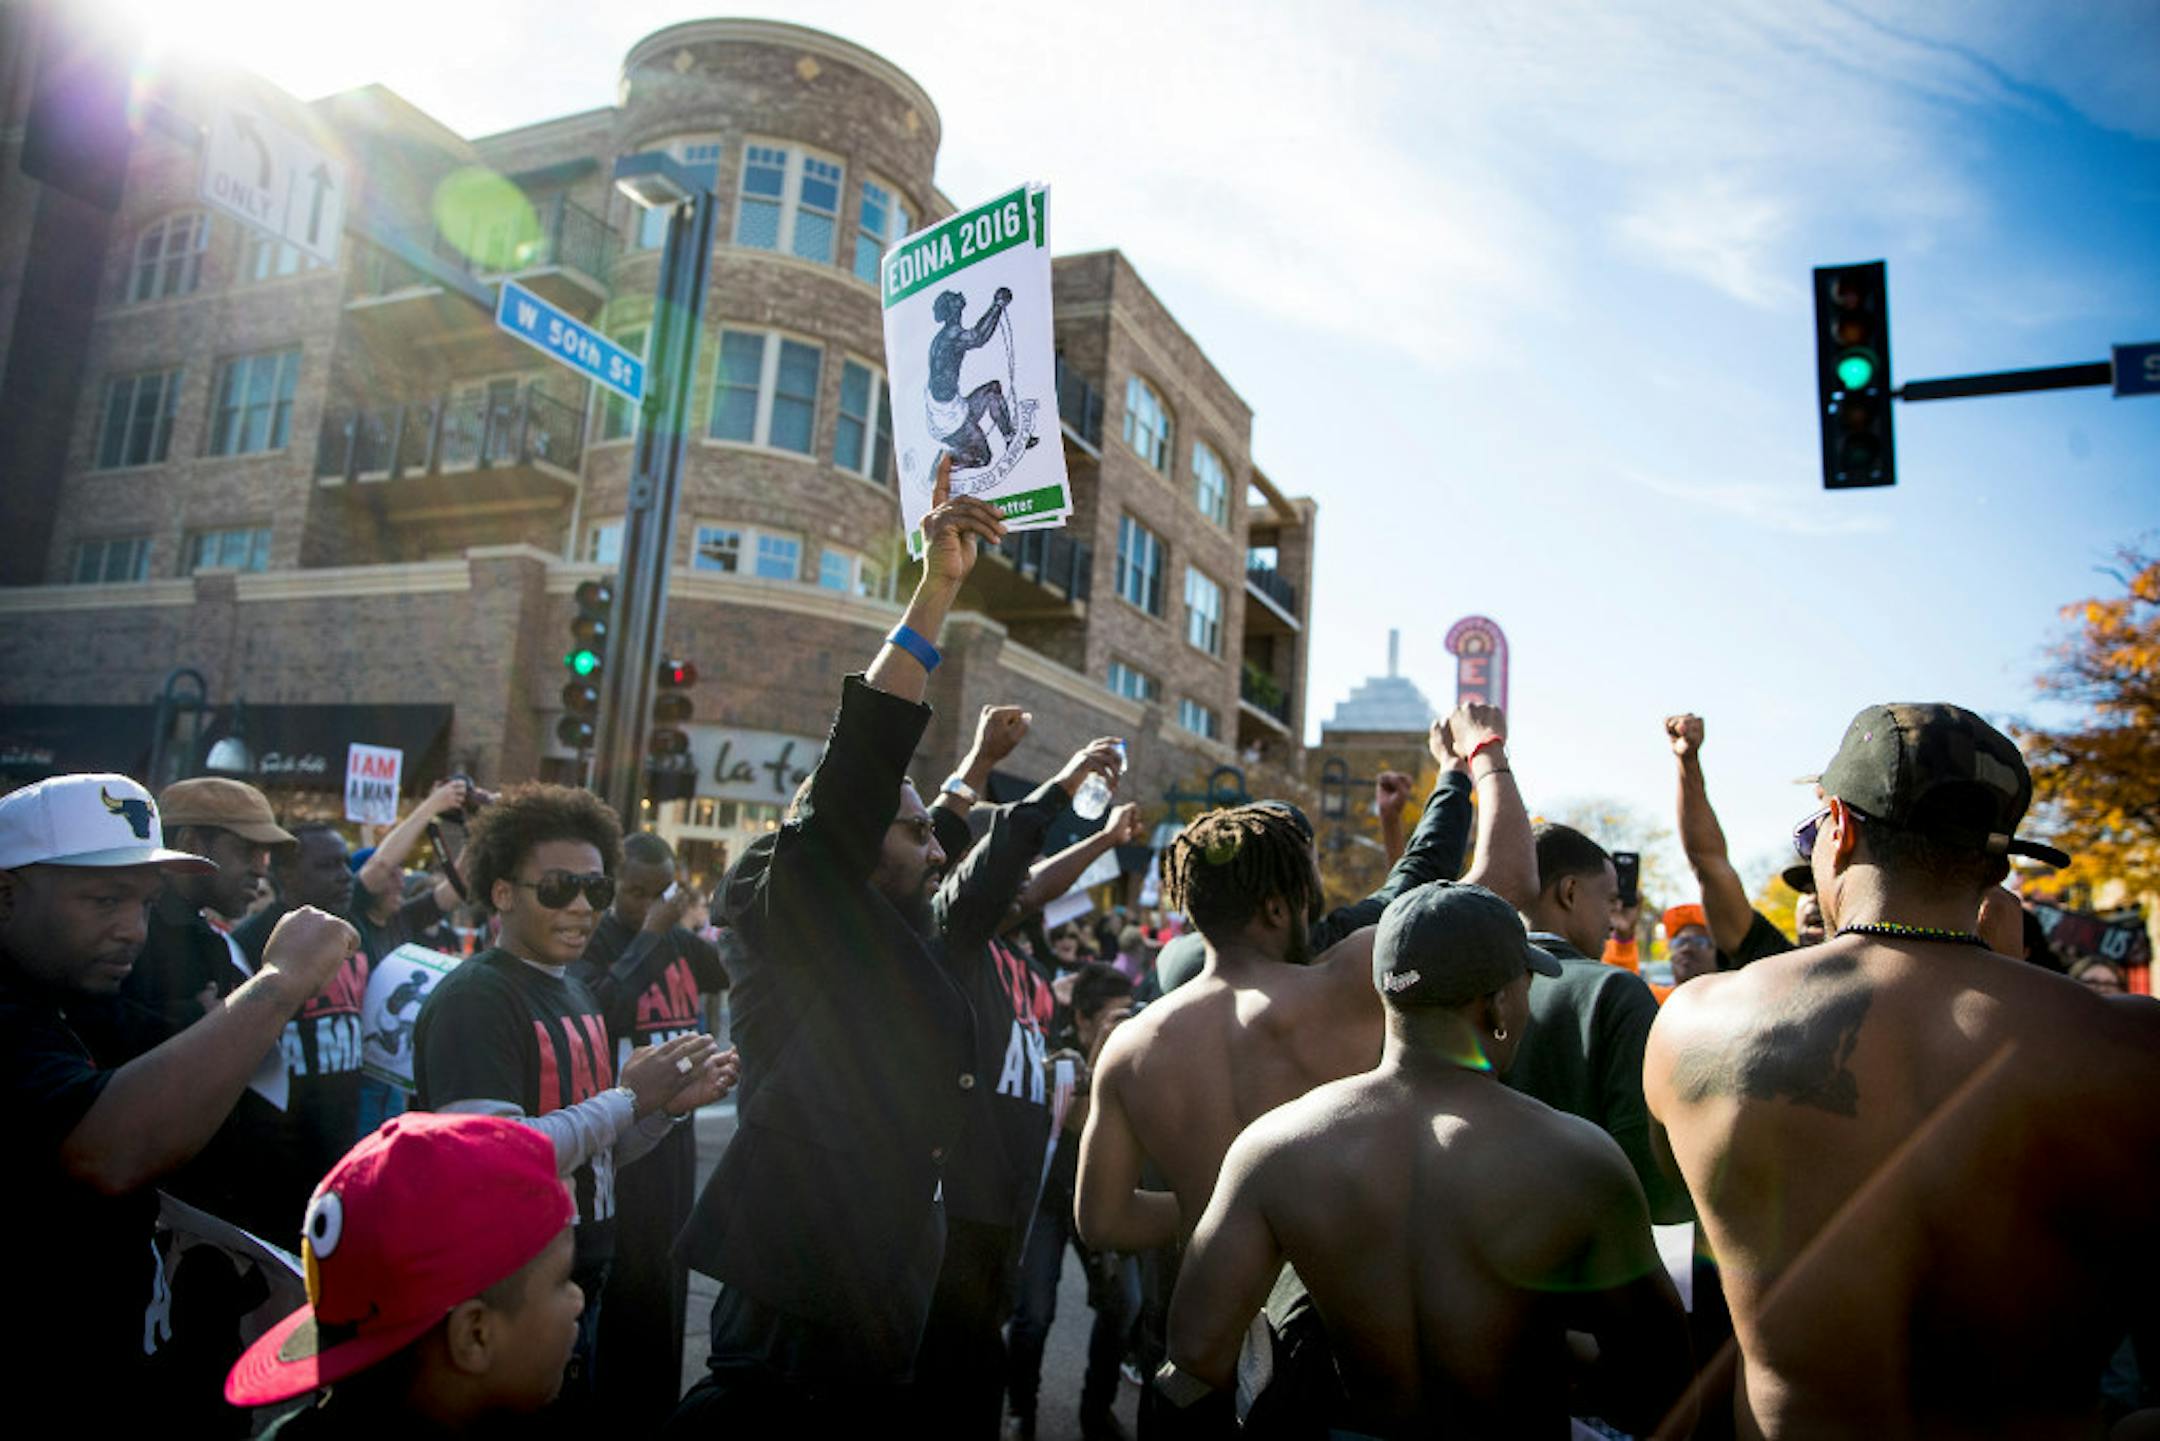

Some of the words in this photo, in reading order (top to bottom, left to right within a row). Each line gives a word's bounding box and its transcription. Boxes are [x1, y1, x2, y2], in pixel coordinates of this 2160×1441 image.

[213, 170, 273, 220] ONLY
[889, 233, 955, 295] EDINA
[959, 201, 1021, 259] 2016
[517, 300, 538, 331] W
[548, 318, 601, 369] 50th
[609, 354, 632, 387] St
[995, 498, 1034, 515] atter
[352, 752, 360, 776] I
[362, 753, 396, 779] AM
[714, 741, 756, 784] la
